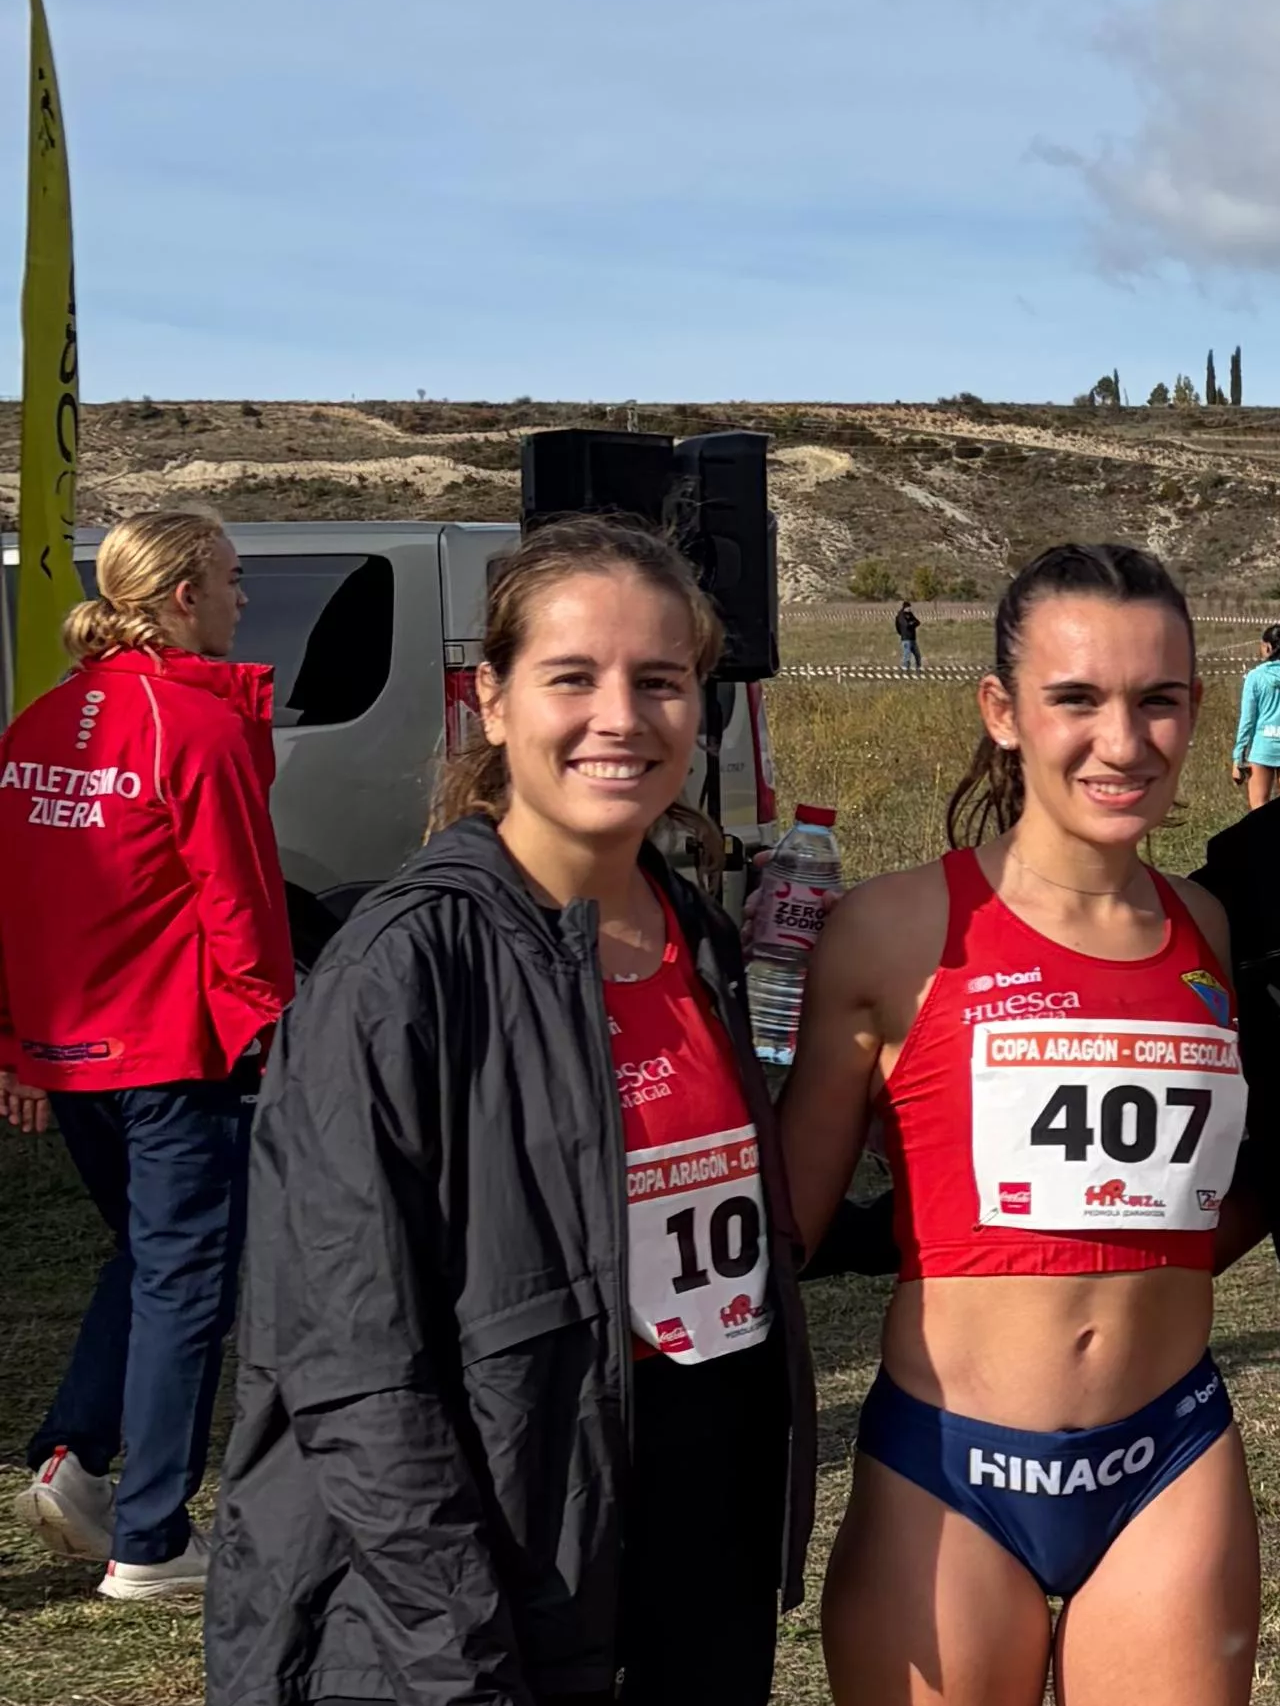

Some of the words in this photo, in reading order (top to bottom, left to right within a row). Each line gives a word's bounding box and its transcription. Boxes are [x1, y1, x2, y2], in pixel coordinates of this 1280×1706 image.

[0, 760, 142, 799] ATLETISMO
[28, 796, 106, 828] ZUERA
[773, 913, 825, 931] SODIO
[776, 901, 826, 920] ZERO
[962, 991, 1081, 1025] Huesca
[991, 1038, 1041, 1062] COPA
[1044, 1034, 1119, 1062] ARAGÓN
[1134, 1040, 1177, 1064] COPA
[1030, 1084, 1213, 1164] 407
[626, 1168, 666, 1197] COPA
[669, 1151, 729, 1188] ARAGÓN
[740, 1144, 759, 1170] CO
[666, 1195, 760, 1294] 10
[968, 1436, 1156, 1496] HINACO
